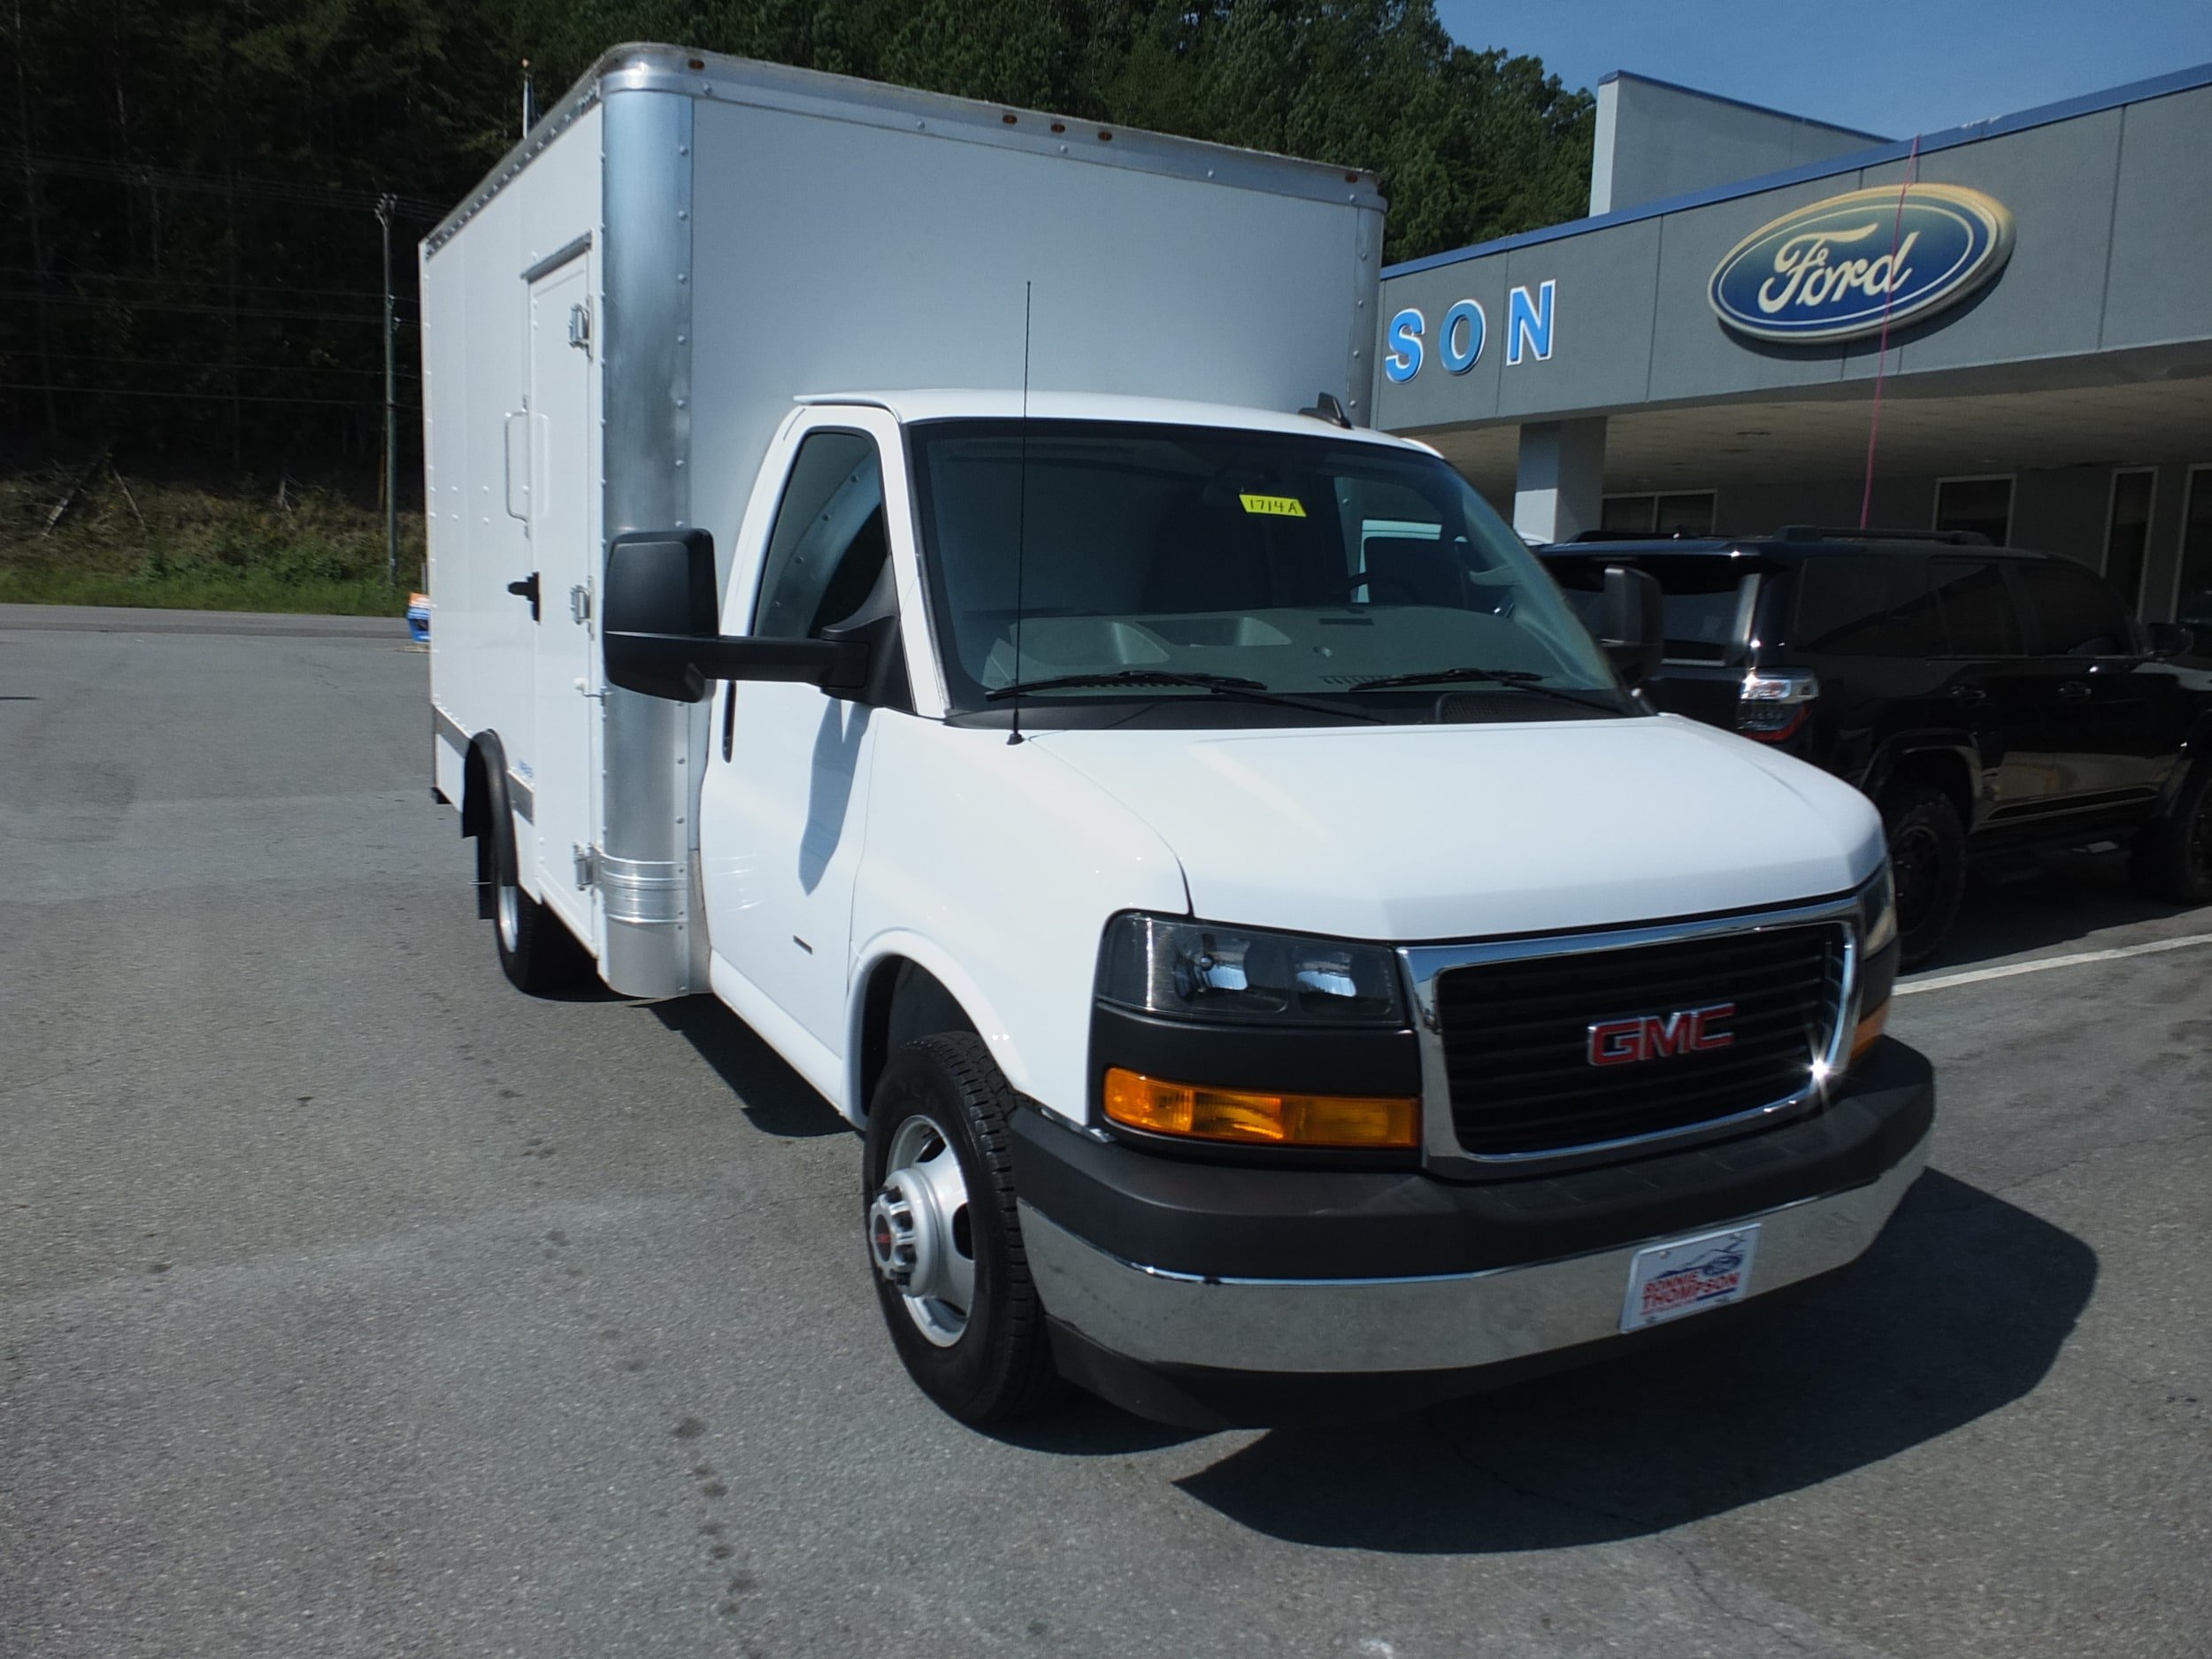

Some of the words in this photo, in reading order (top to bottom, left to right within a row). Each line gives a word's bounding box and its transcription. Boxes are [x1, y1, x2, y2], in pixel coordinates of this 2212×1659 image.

[1757, 222, 1921, 314] Ford
[1385, 279, 1556, 384] SON
[1249, 498, 1298, 514] 1714A
[1587, 1002, 1736, 1066] GMC
